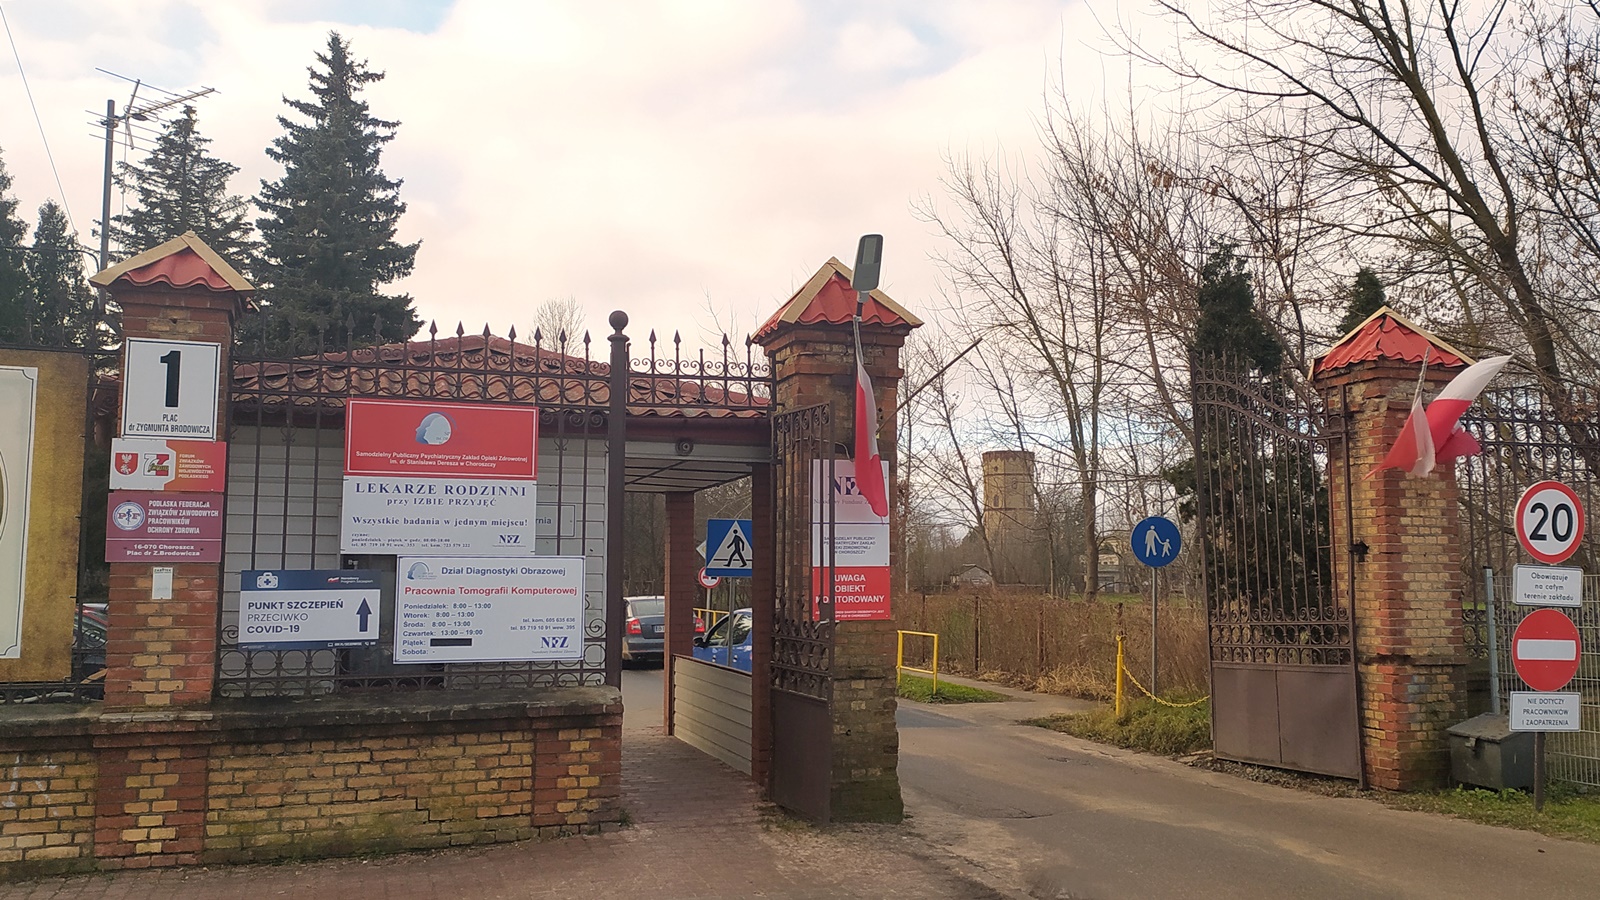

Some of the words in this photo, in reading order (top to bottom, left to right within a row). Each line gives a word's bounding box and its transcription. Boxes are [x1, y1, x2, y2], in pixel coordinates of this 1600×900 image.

[160, 350, 181, 407] 1
[163, 414, 178, 422] PLAC
[136, 423, 169, 432] ZYGMUNTA
[170, 425, 210, 433] BRODOWICZA
[355, 482, 437, 494] LEKARZE
[444, 485, 526, 496] RODZINNI
[448, 498, 497, 507] PRZYJĘĆ
[148, 517, 190, 525] PRACOWNIKÓW
[352, 516, 400, 526] Wszystkie
[454, 518, 488, 527] jednym
[491, 519, 528, 528] miejscu!
[1529, 502, 1573, 542] 20
[466, 567, 518, 576] Diagnostyki
[521, 567, 566, 576] Obrazowej
[405, 587, 455, 595] Pracownia
[459, 587, 508, 596] Tomografii
[511, 587, 577, 596] Komputerowej
[816, 595, 884, 603] MOITOROWANY
[248, 601, 284, 610] PUNKT
[287, 598, 343, 609] SZCZEPIEŃ
[248, 613, 308, 622] PRZECIWKO
[247, 625, 300, 634] COVID-19
[541, 637, 569, 648] NFZ
